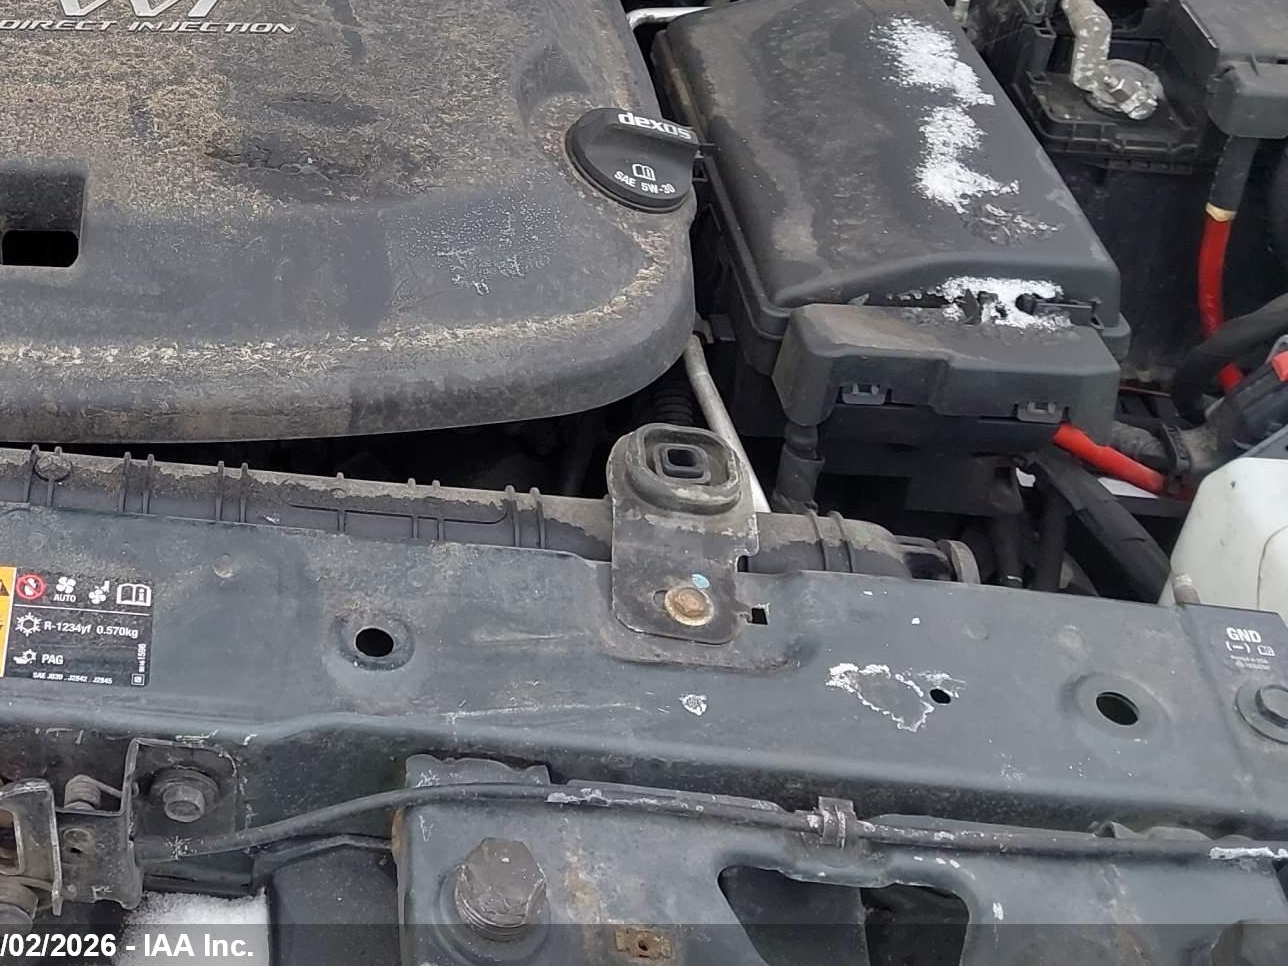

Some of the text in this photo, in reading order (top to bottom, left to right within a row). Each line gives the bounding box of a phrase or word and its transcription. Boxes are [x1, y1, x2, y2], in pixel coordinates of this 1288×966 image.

[127, 20, 296, 34] INJECTION
[617, 112, 692, 140] dexos
[614, 170, 676, 194] SAE 5W-30
[53, 594, 77, 603] AUTO
[43, 622, 139, 639] R-1234yf 0.570kg
[1226, 627, 1261, 643] GND
[41, 653, 64, 665] PAG
